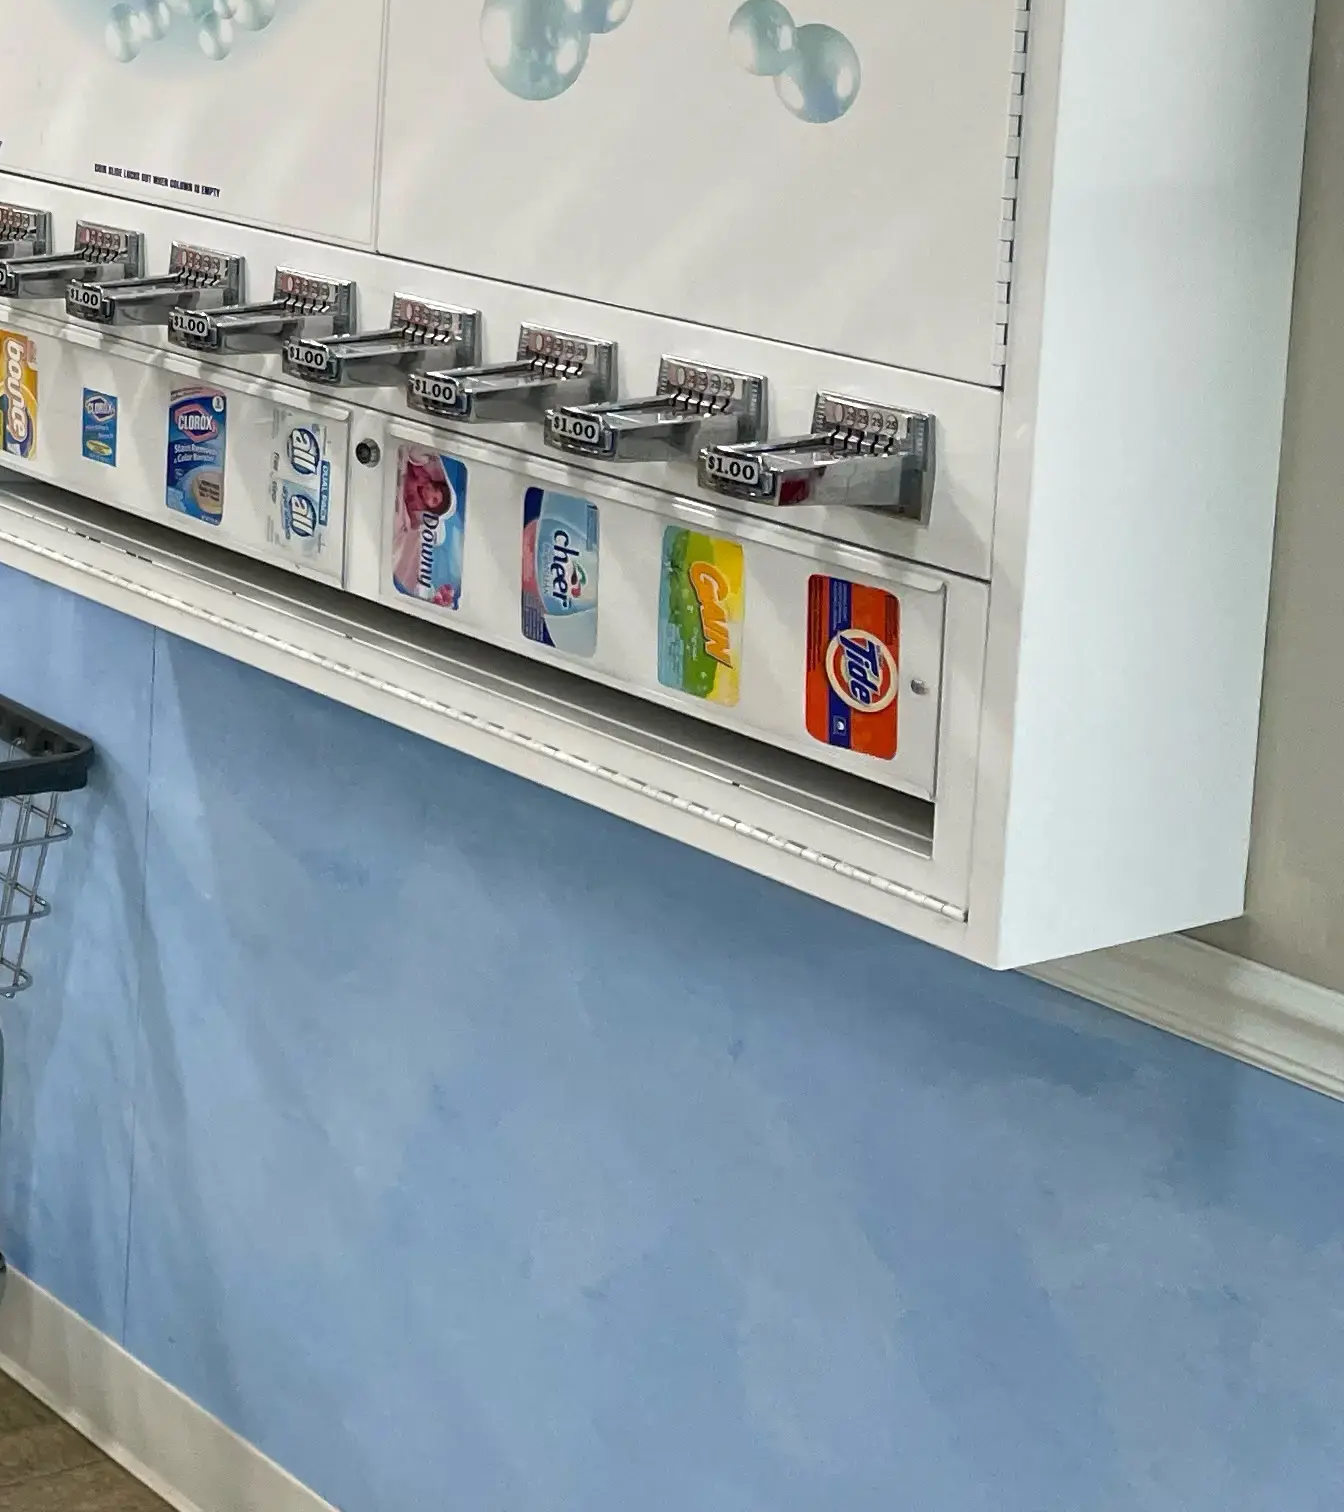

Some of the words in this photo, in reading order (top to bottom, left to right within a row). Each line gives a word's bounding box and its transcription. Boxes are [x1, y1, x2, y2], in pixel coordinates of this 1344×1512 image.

[201, 185, 221, 198] EMPTY
[70, 288, 100, 307] $1.00
[173, 315, 206, 334] $1.00
[289, 344, 324, 367] $1.00
[6, 338, 28, 439] bounce
[414, 379, 454, 401] $1.00
[176, 414, 214, 432] CLOROX
[553, 415, 597, 440] $1.00
[291, 428, 318, 476] all
[707, 455, 755, 481] $1.00
[291, 495, 315, 538] all
[416, 512, 440, 589] Downy
[550, 529, 581, 609] cheer
[838, 632, 881, 707] Tide
